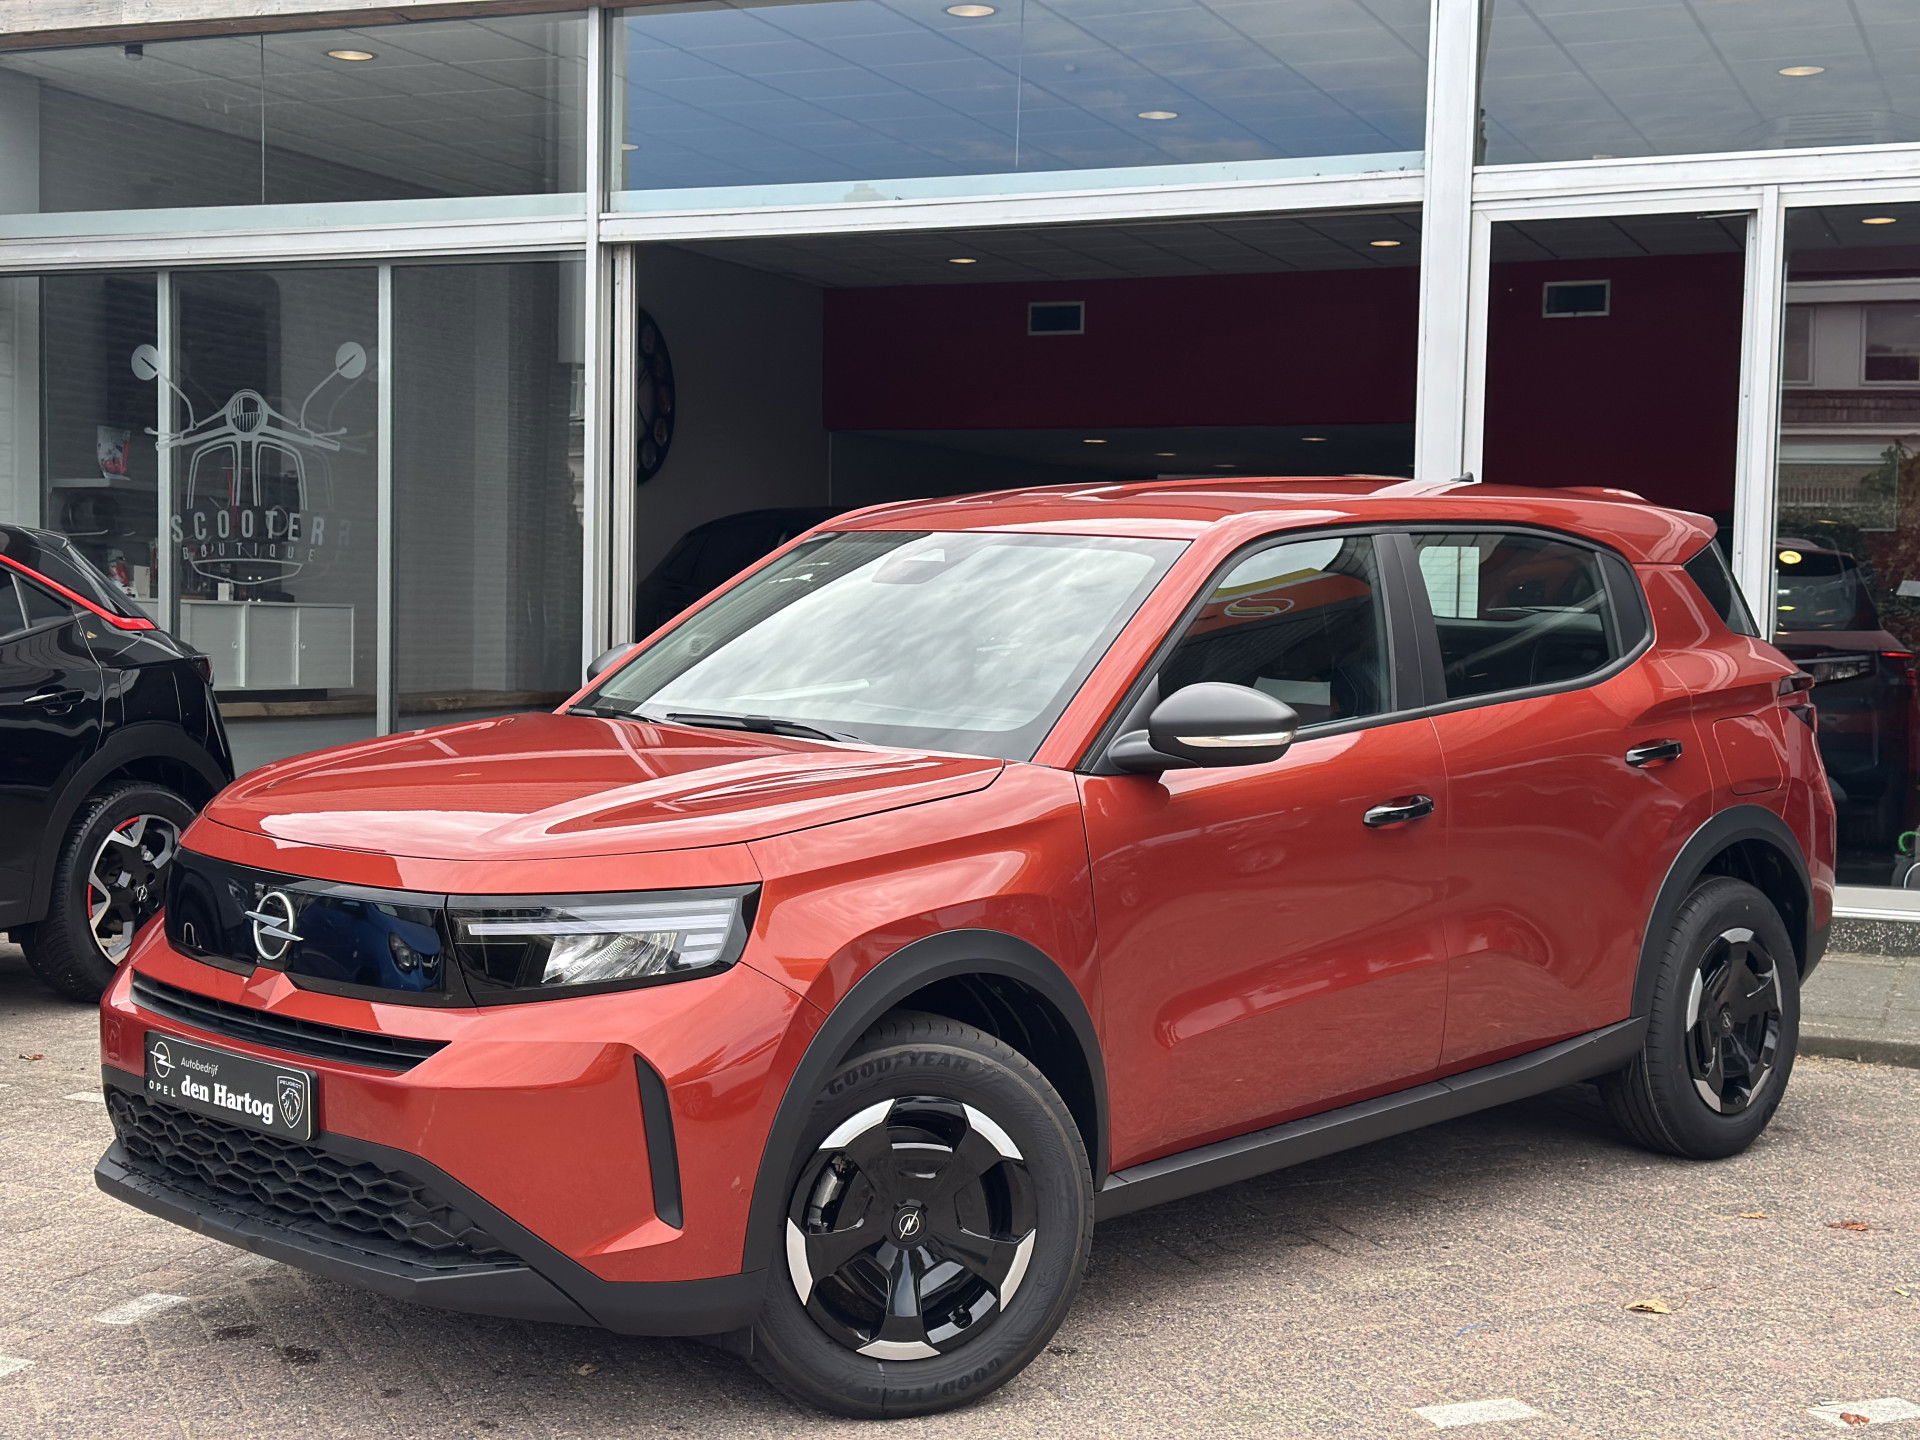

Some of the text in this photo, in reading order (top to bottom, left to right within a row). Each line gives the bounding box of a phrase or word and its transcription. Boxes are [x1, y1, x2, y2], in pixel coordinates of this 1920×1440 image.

[170, 509, 325, 546] SCOOTER
[182, 542, 320, 562] BOUTIQUE
[180, 1057, 219, 1077] Autobedrijf
[827, 1051, 970, 1095] GOODYEAR
[148, 1080, 176, 1098] OPEL
[279, 1079, 302, 1089] PEUGEOT
[180, 1074, 274, 1125] den Hartog
